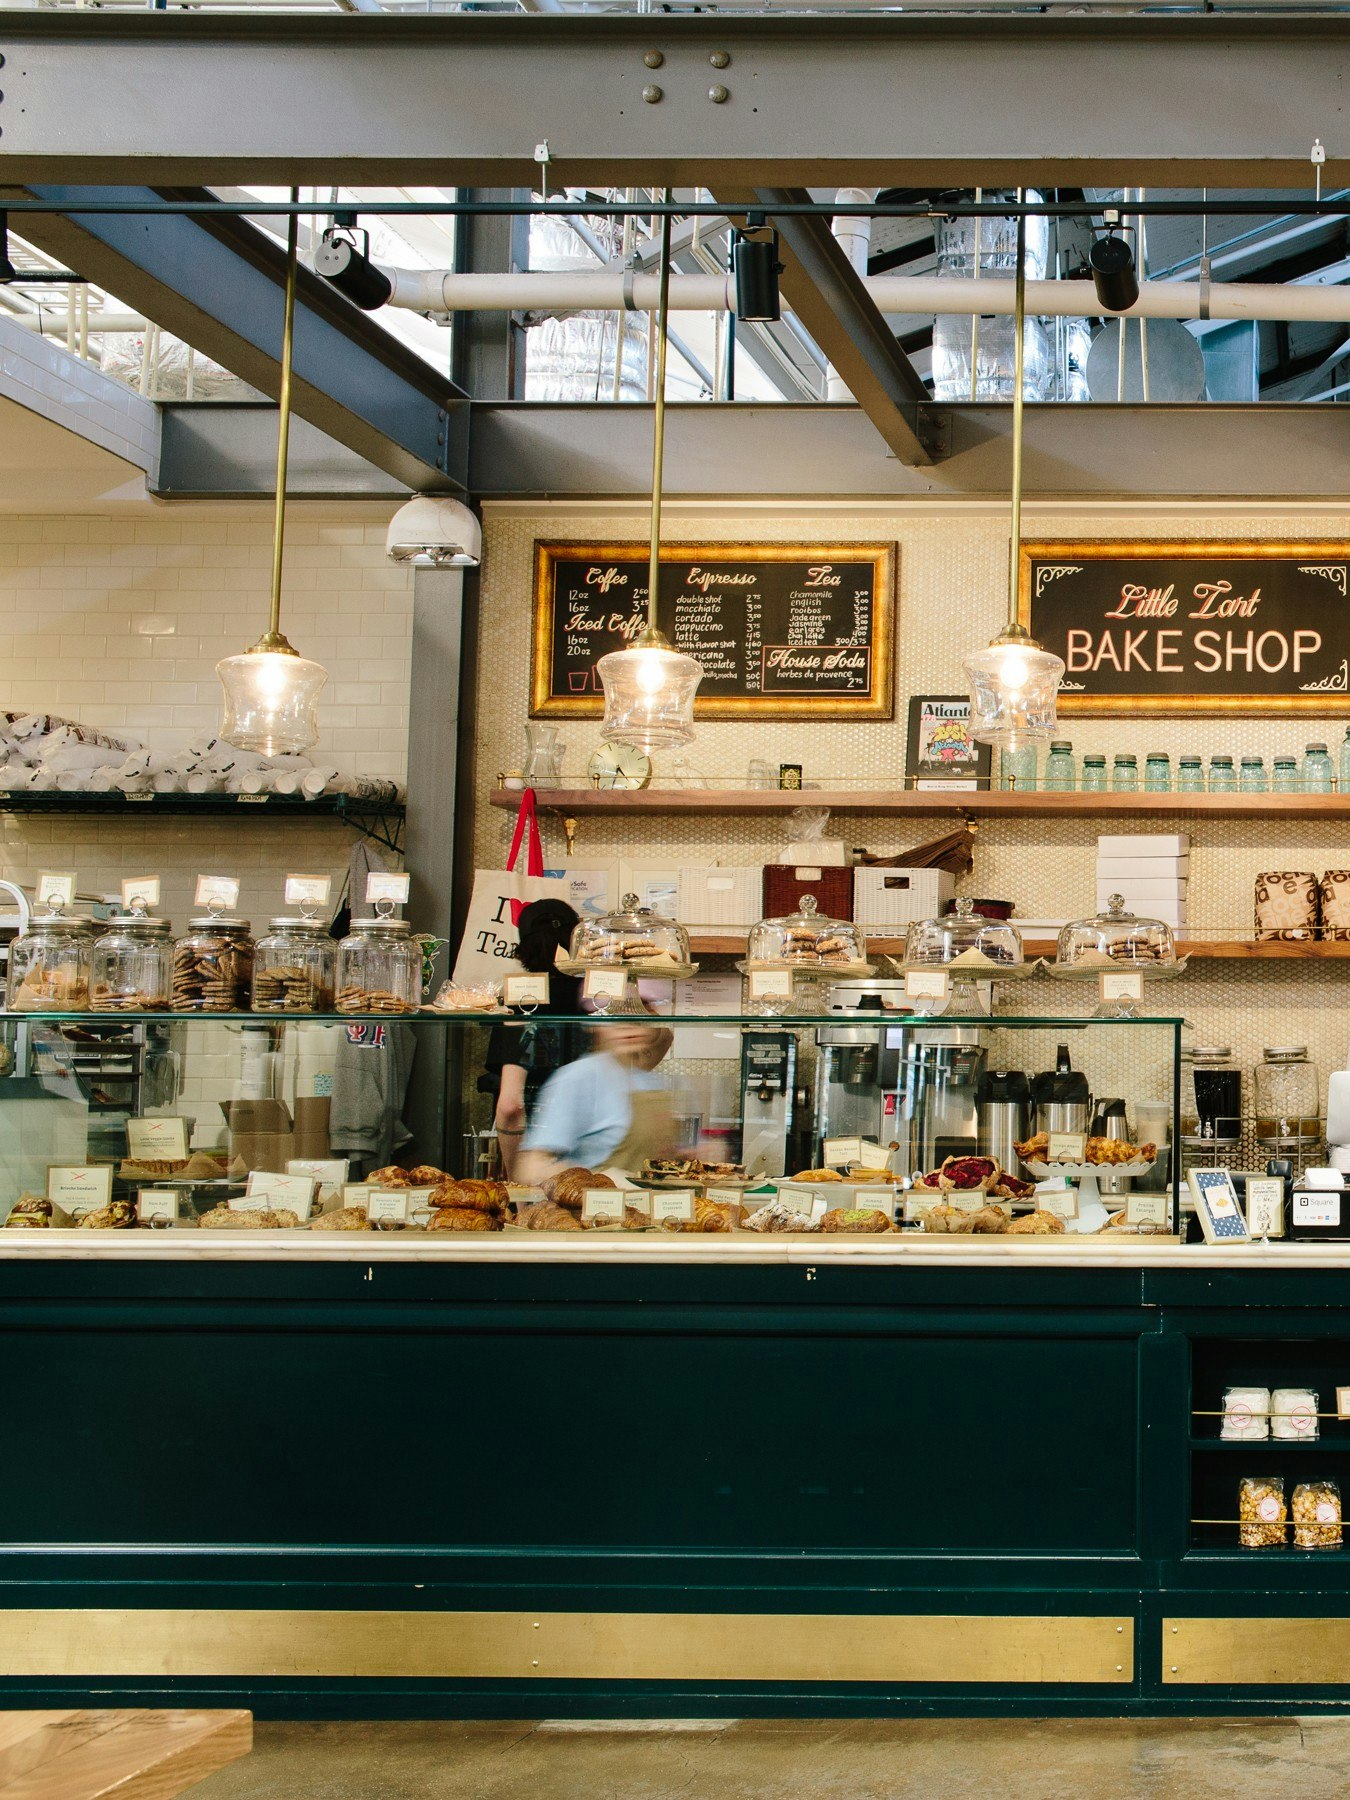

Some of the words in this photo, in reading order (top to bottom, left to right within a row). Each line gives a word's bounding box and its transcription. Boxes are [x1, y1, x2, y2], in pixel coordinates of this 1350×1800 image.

[586, 568, 628, 593] Coffee
[686, 568, 757, 592] Espresso
[804, 566, 841, 586] Tea
[677, 595, 703, 603] double
[705, 595, 722, 603] shot
[791, 599, 821, 607] english
[1105, 583, 1179, 620] Little
[1188, 580, 1261, 621] Tart
[569, 602, 589, 612] 16oz
[676, 604, 721, 612] macchiato
[564, 613, 605, 631] Iced
[676, 613, 712, 622] cortado
[676, 632, 699, 640] latte
[789, 626, 807, 634] earl
[568, 635, 588, 644] 16oz
[567, 646, 590, 655] 20oz
[1066, 629, 1184, 672] BAKE
[1193, 629, 1322, 673] SHOP
[700, 659, 735, 668] hocolate
[766, 649, 820, 668] House
[823, 650, 865, 670] Soda
[777, 669, 802, 678] herbes
[816, 671, 852, 681] provence
[924, 704, 970, 717] Atlant
[490, 896, 510, 924] I
[476, 930, 520, 960] Ta
